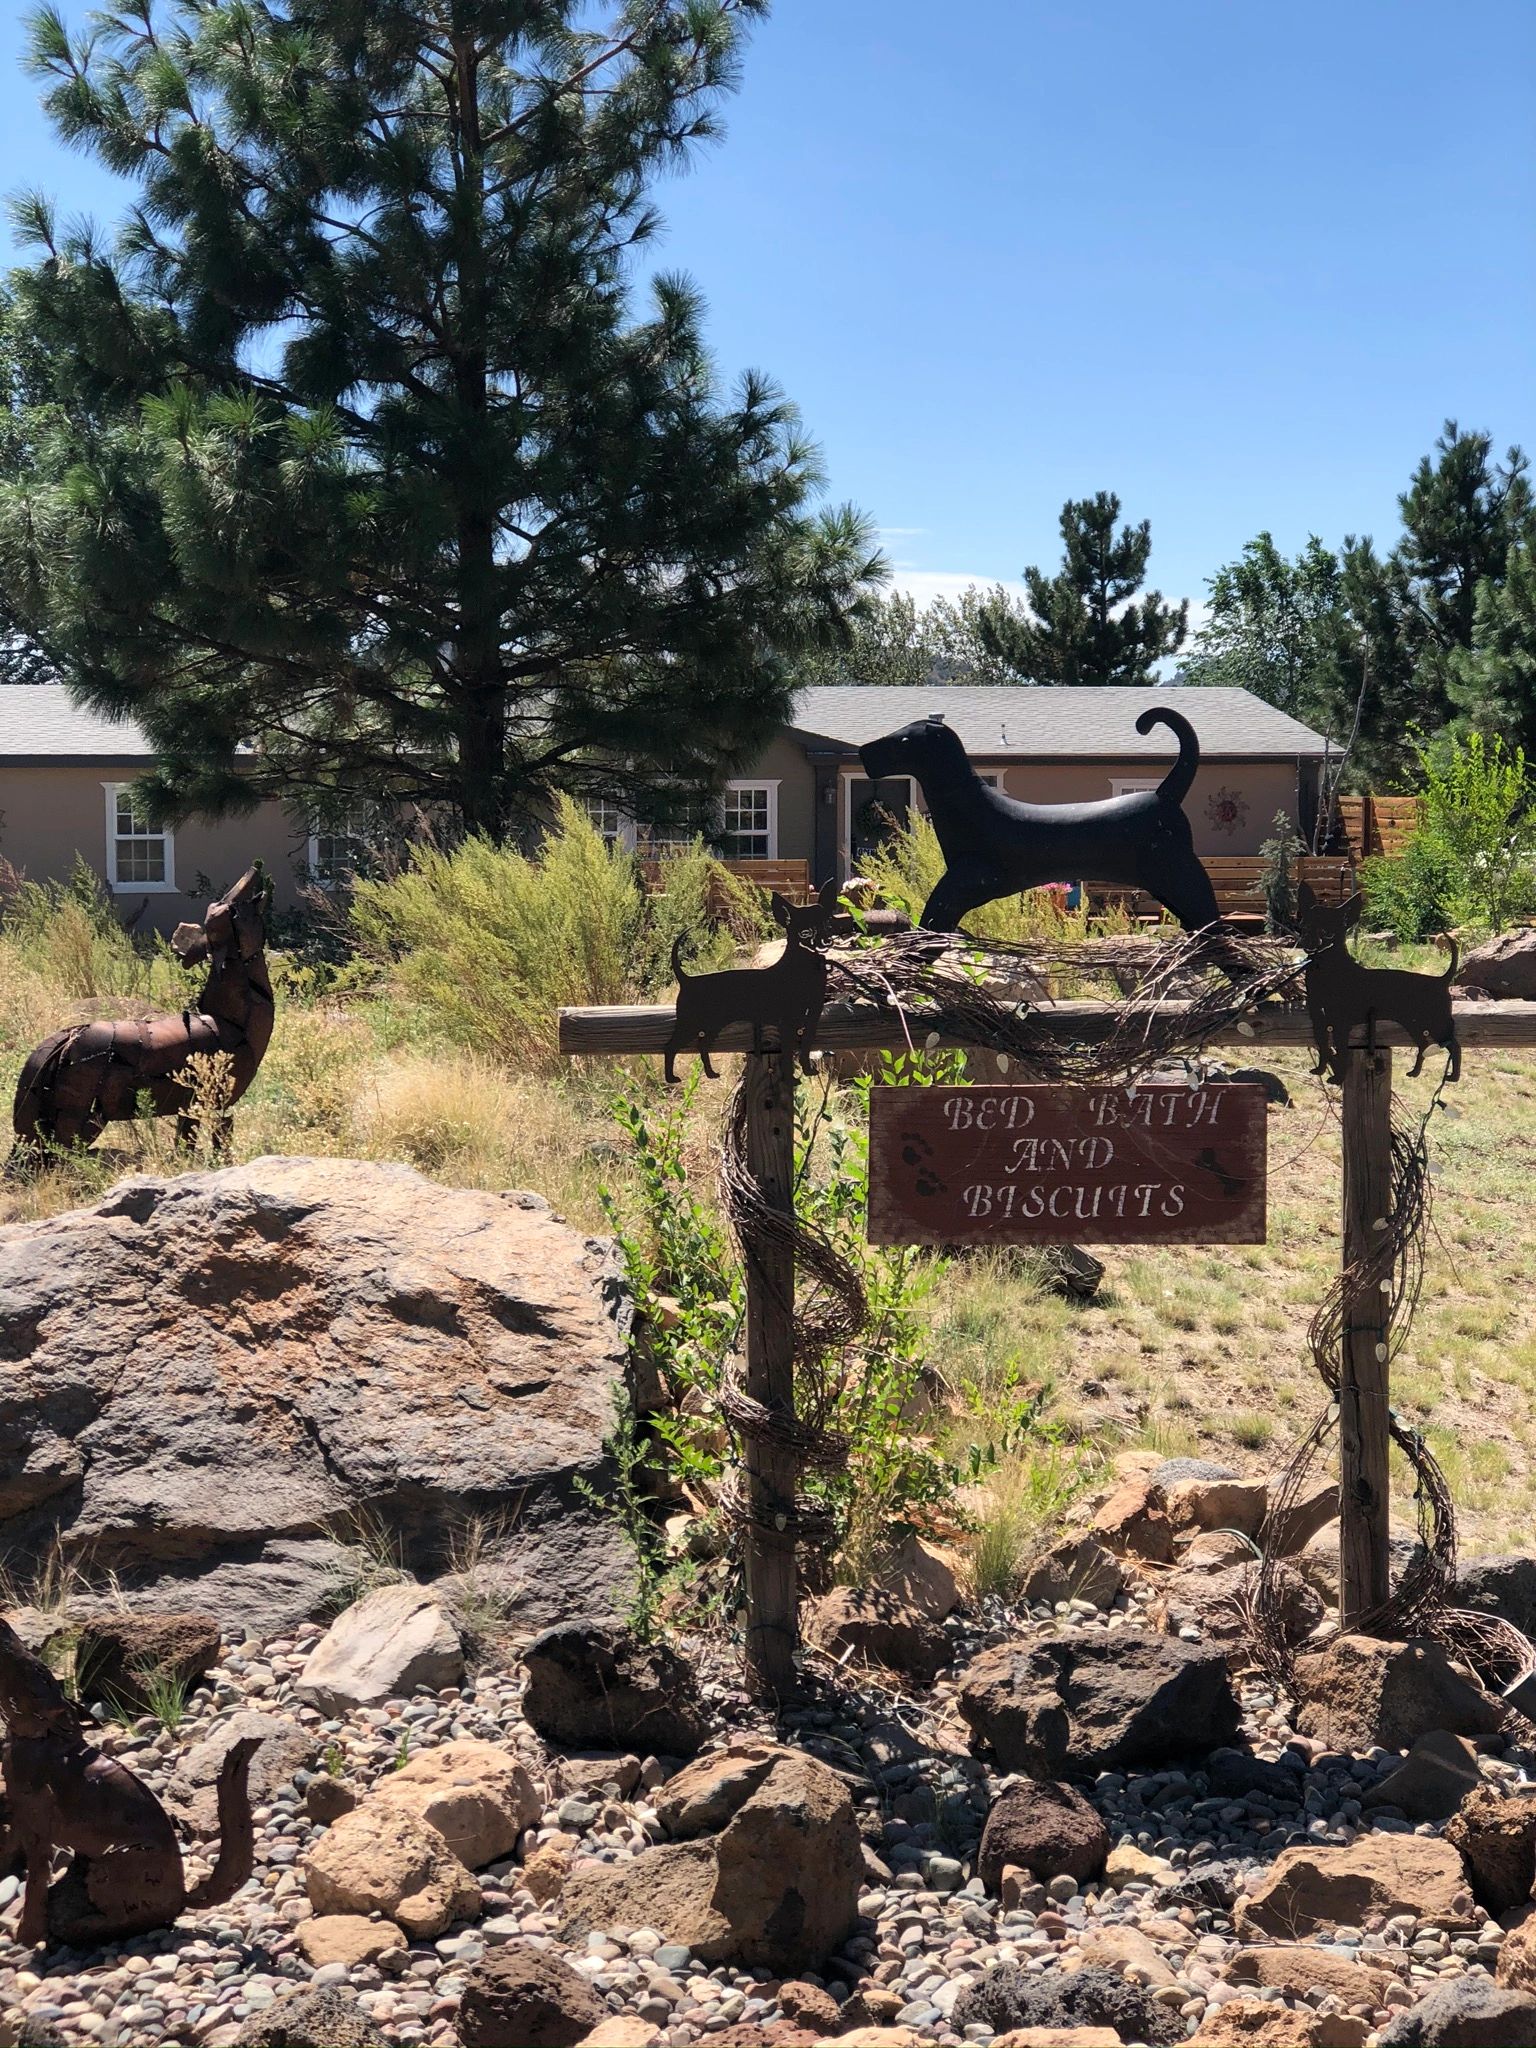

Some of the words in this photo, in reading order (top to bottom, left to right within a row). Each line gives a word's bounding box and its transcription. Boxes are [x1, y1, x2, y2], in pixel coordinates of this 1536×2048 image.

[943, 1096, 1035, 1131] BED
[1089, 1090, 1227, 1129] BATH
[1004, 1136, 1115, 1174] AND
[962, 1184, 1186, 1219] BISCUITS
